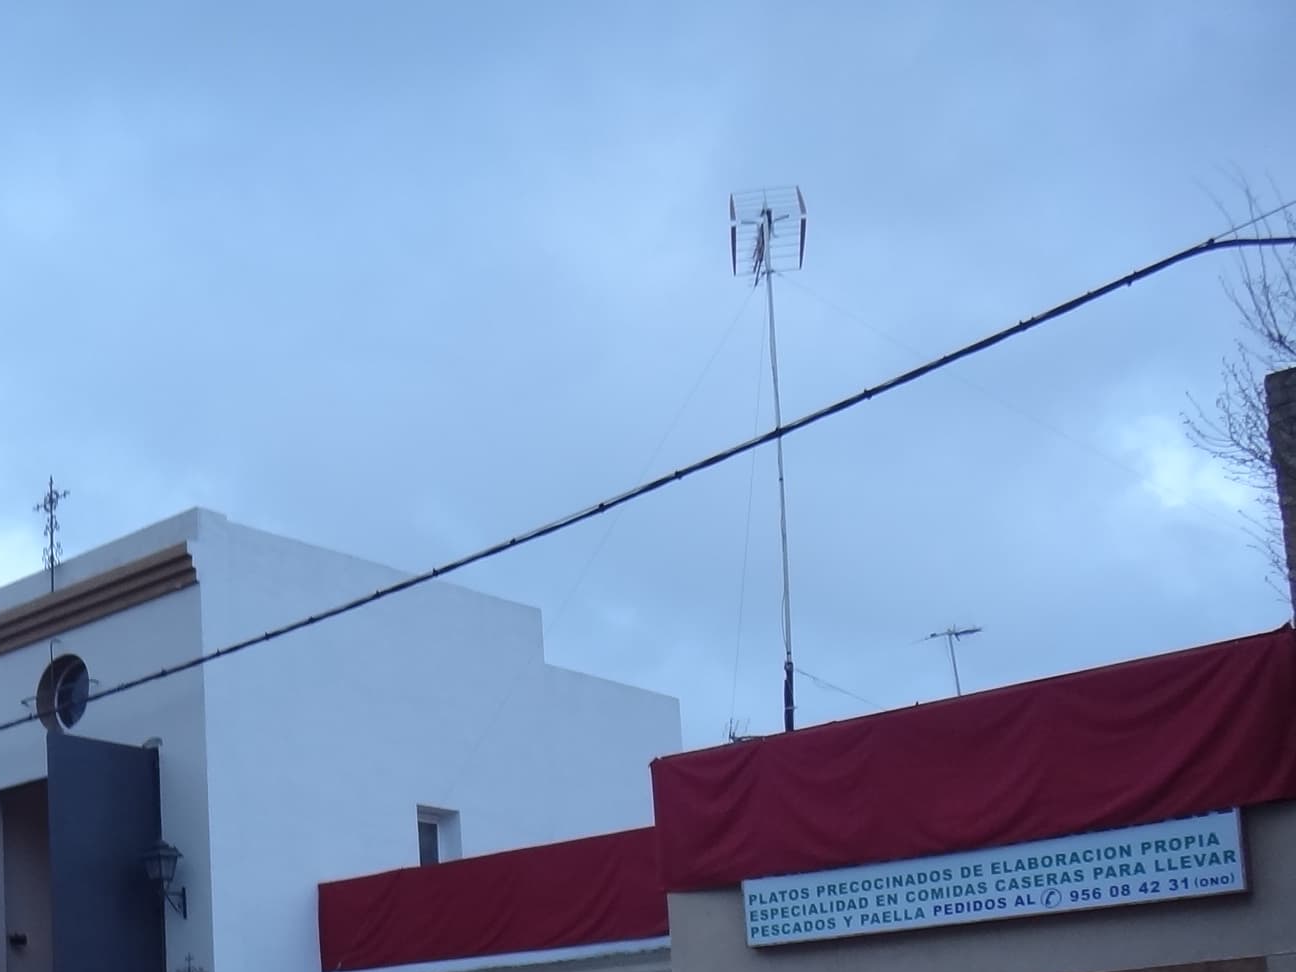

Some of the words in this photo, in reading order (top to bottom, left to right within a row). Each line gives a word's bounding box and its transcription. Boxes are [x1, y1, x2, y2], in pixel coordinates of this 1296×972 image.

[749, 887, 810, 906] PLATOS
[816, 868, 953, 898] PRECOCINADOS
[960, 864, 983, 879] DE
[991, 844, 1132, 876] ELABORACION
[1141, 831, 1221, 856] PROPIA
[749, 896, 869, 922] ESPECIALIDAD
[876, 892, 898, 907] EN
[906, 881, 988, 903] COMIDAS
[995, 868, 1085, 892] CASERAS
[1093, 861, 1146, 881] PARA
[1155, 849, 1237, 873] LLEVAR
[750, 917, 836, 938] PESCADOS
[842, 914, 854, 928] Y
[860, 907, 926, 926] PAELLA
[933, 896, 1007, 917] PEDIDOS
[1013, 893, 1036, 907] AL
[1069, 886, 1102, 902] 956
[1109, 883, 1131, 898] 08
[1138, 881, 1161, 894] 42
[1168, 876, 1189, 891] 31
[1194, 873, 1235, 889] (ONO)
